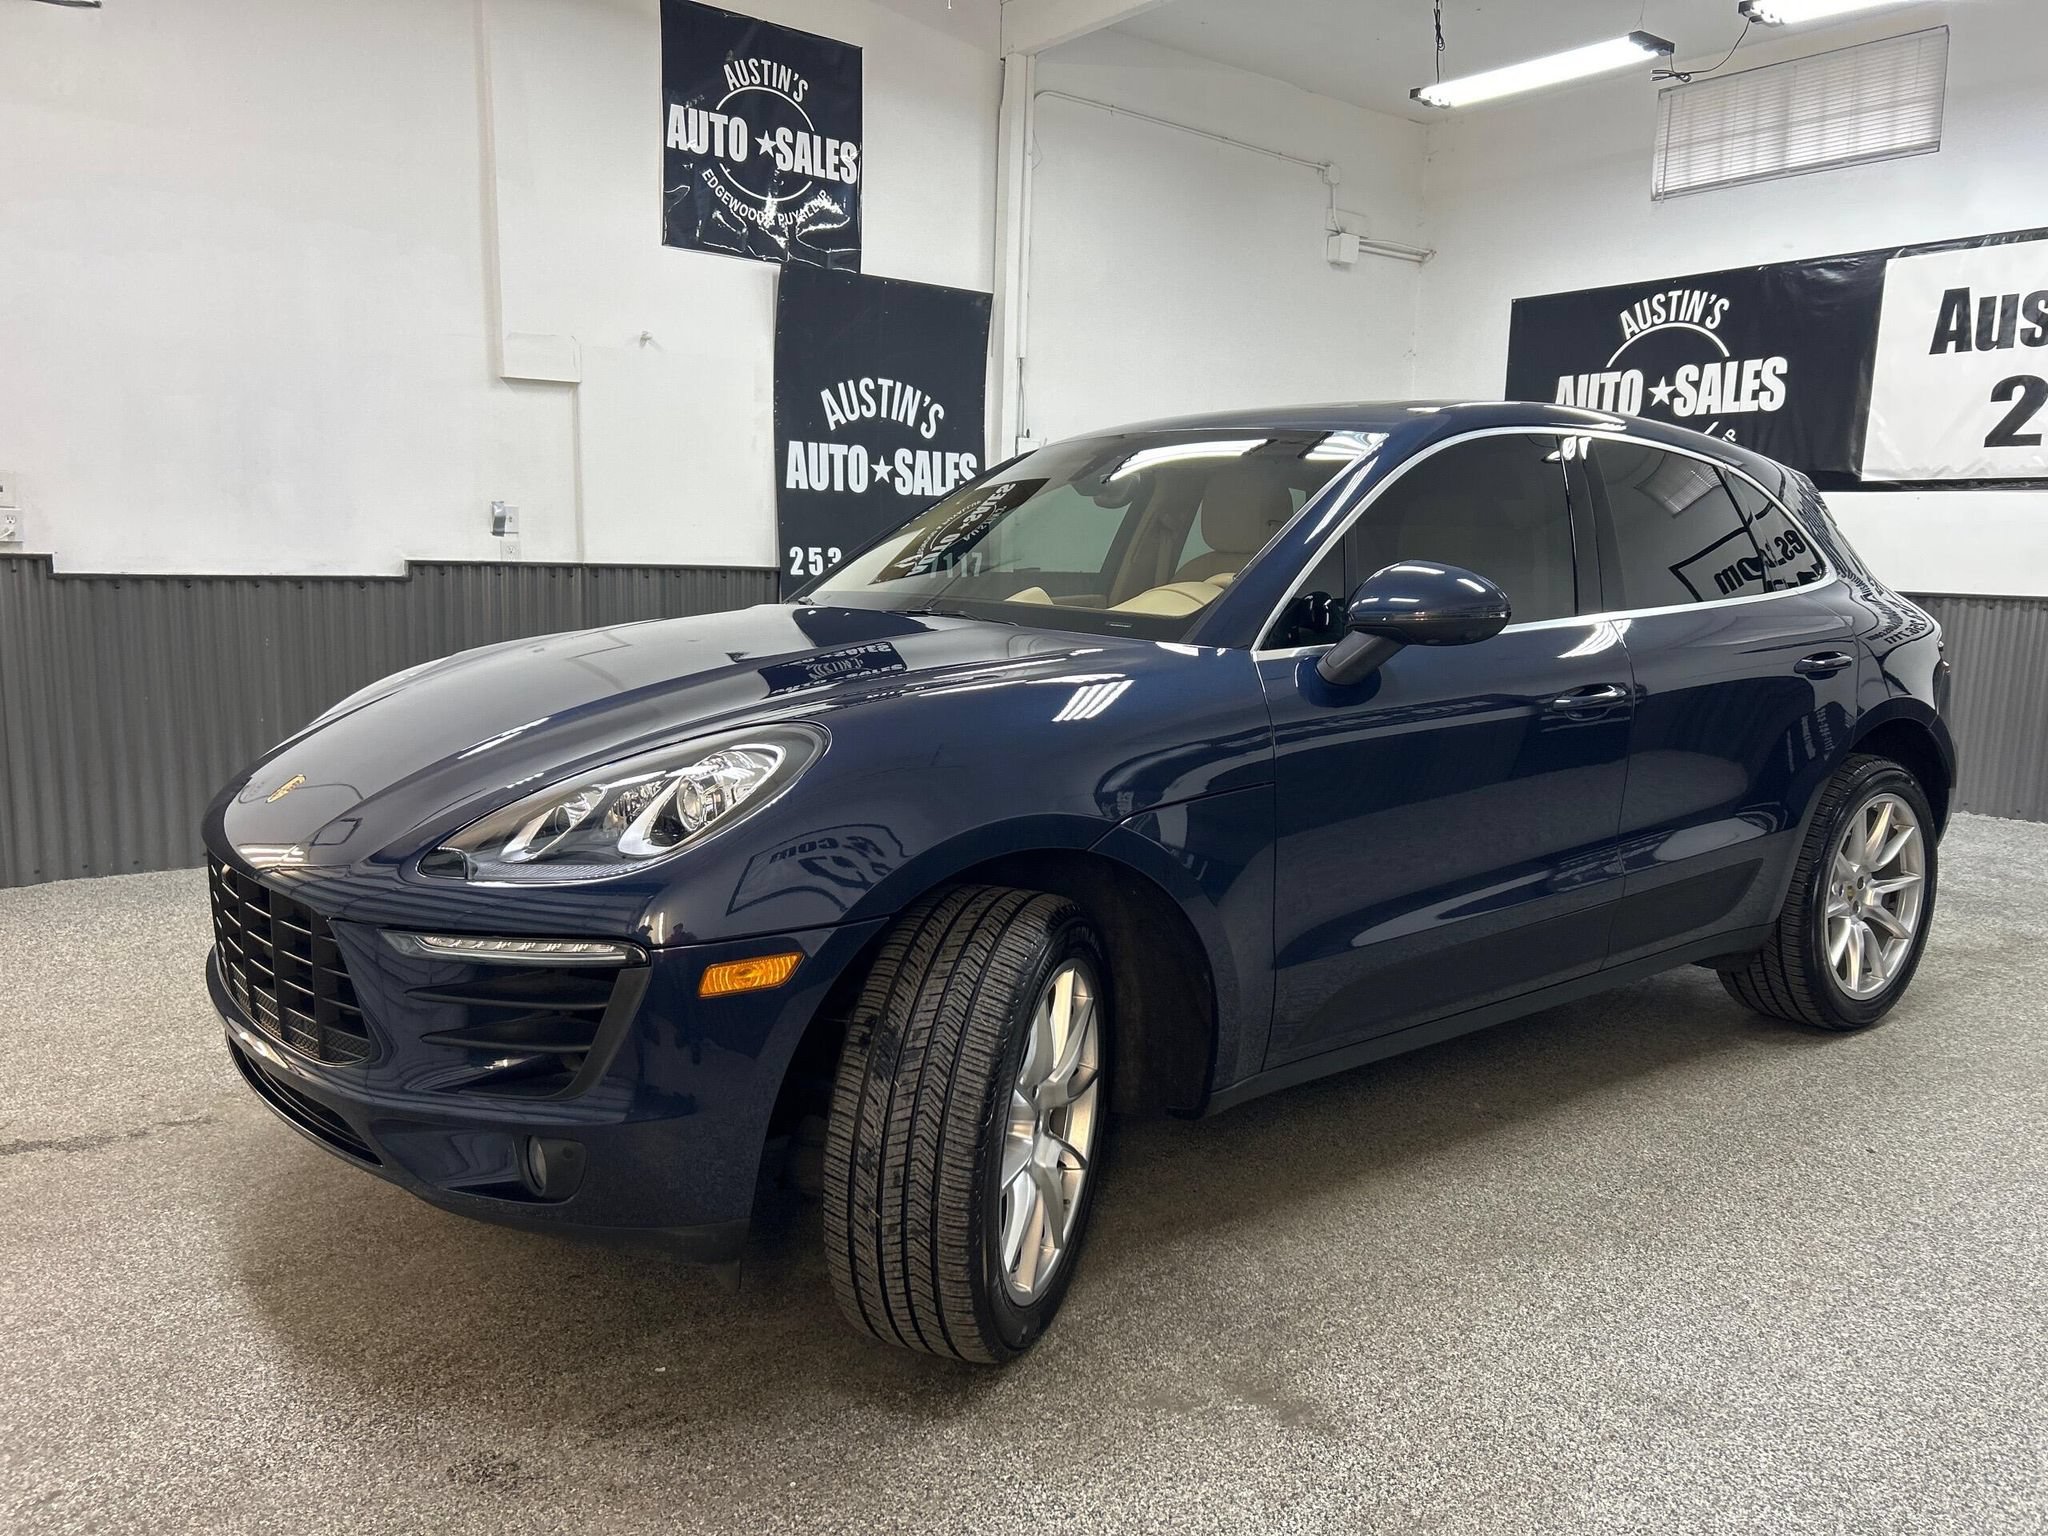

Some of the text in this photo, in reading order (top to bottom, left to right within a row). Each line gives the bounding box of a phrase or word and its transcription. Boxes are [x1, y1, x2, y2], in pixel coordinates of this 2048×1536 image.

[723, 58, 809, 102] AUSTIN'S
[666, 103, 858, 185] AUTO SALES
[701, 168, 767, 224] EDGEWOOD
[1618, 288, 1731, 341] AUSTIN'S
[820, 377, 945, 440] AUSTIN'S
[1554, 356, 1788, 417] AUTO SALES
[786, 440, 978, 497] AUTO SALES
